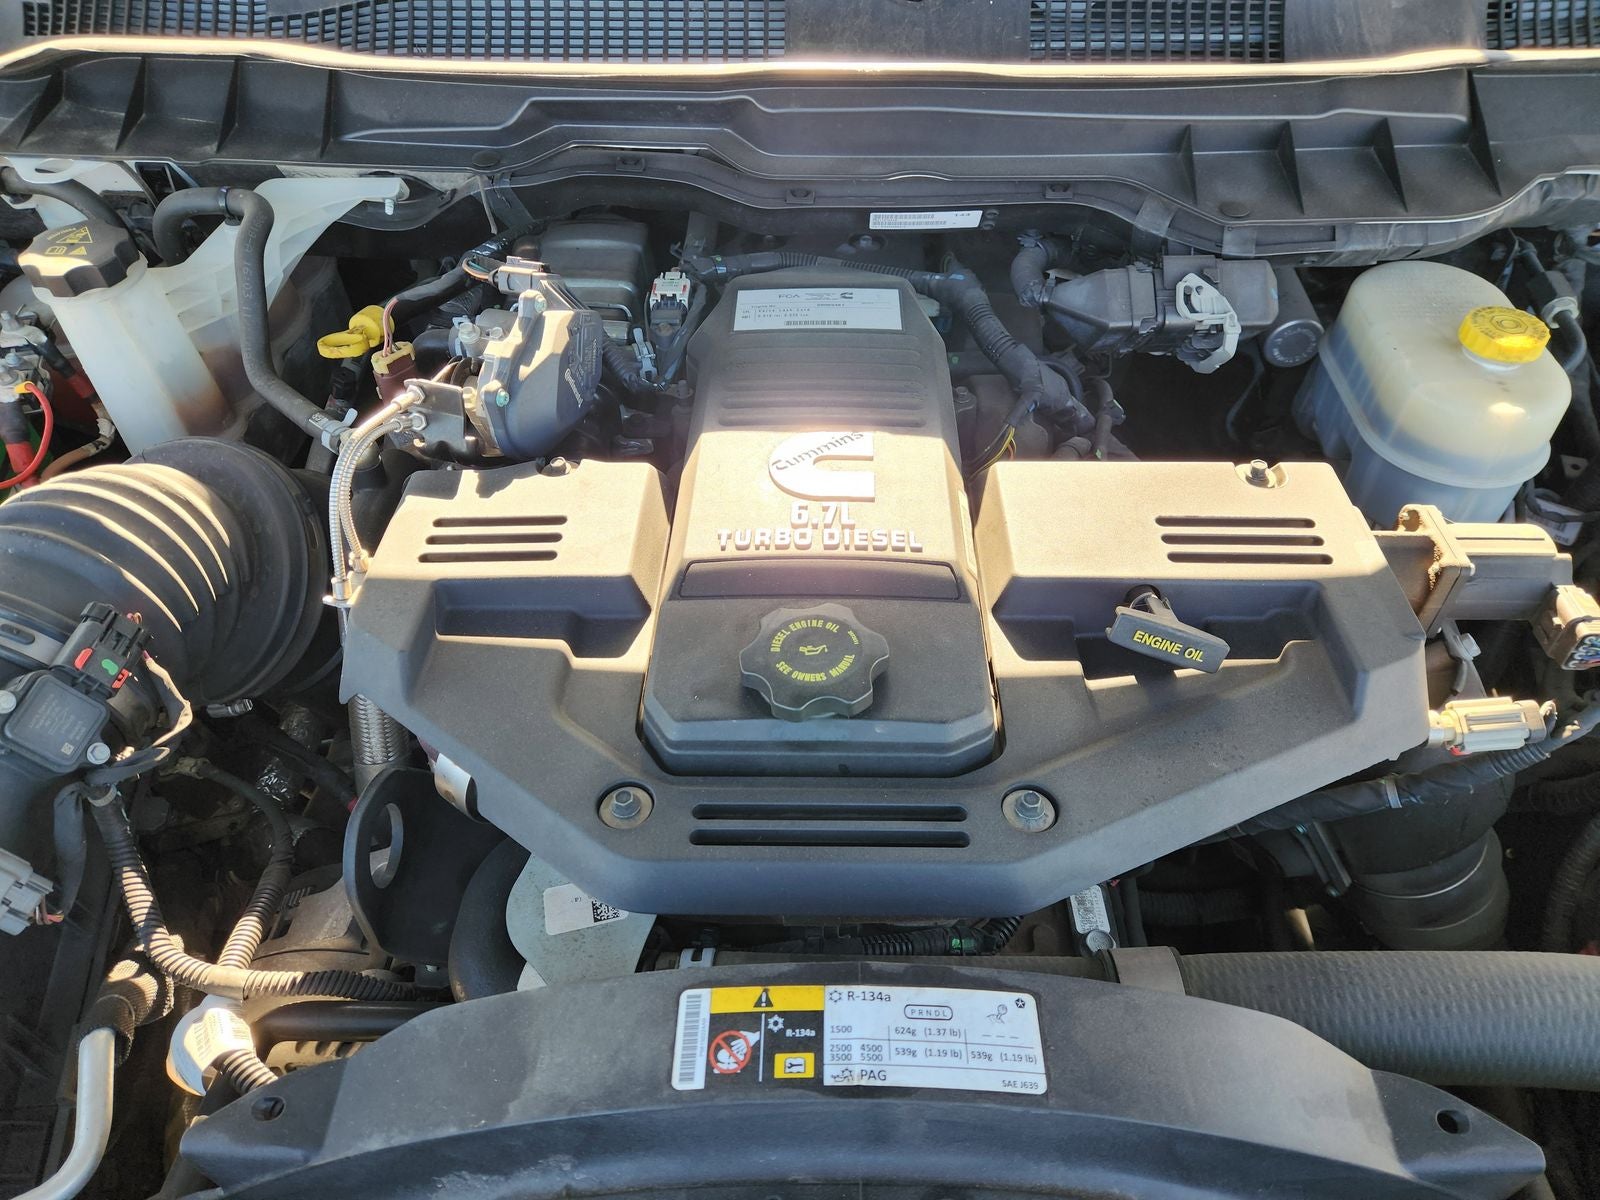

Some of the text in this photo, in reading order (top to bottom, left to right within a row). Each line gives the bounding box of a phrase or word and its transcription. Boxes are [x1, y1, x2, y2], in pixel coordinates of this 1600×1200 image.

[771, 431, 865, 471] Cummins
[790, 502, 856, 529] 6.7L
[717, 527, 924, 553] TURBO DIESEL
[770, 619, 840, 652] DIESEL ENGINE OIL
[1132, 630, 1204, 662] ENGINE OIL
[775, 654, 856, 682] SEE OWNERS MANUAL
[847, 990, 892, 1002] R-134a
[785, 1028, 816, 1037] R-134a
[829, 1025, 853, 1034] 1500
[894, 1026, 917, 1037] 624g
[829, 1043, 883, 1053] 2500 4500
[894, 1047, 918, 1058] 539g
[829, 1053, 883, 1062] 3500 5500
[970, 1050, 993, 1062] 539g
[860, 1069, 887, 1081] PAG
